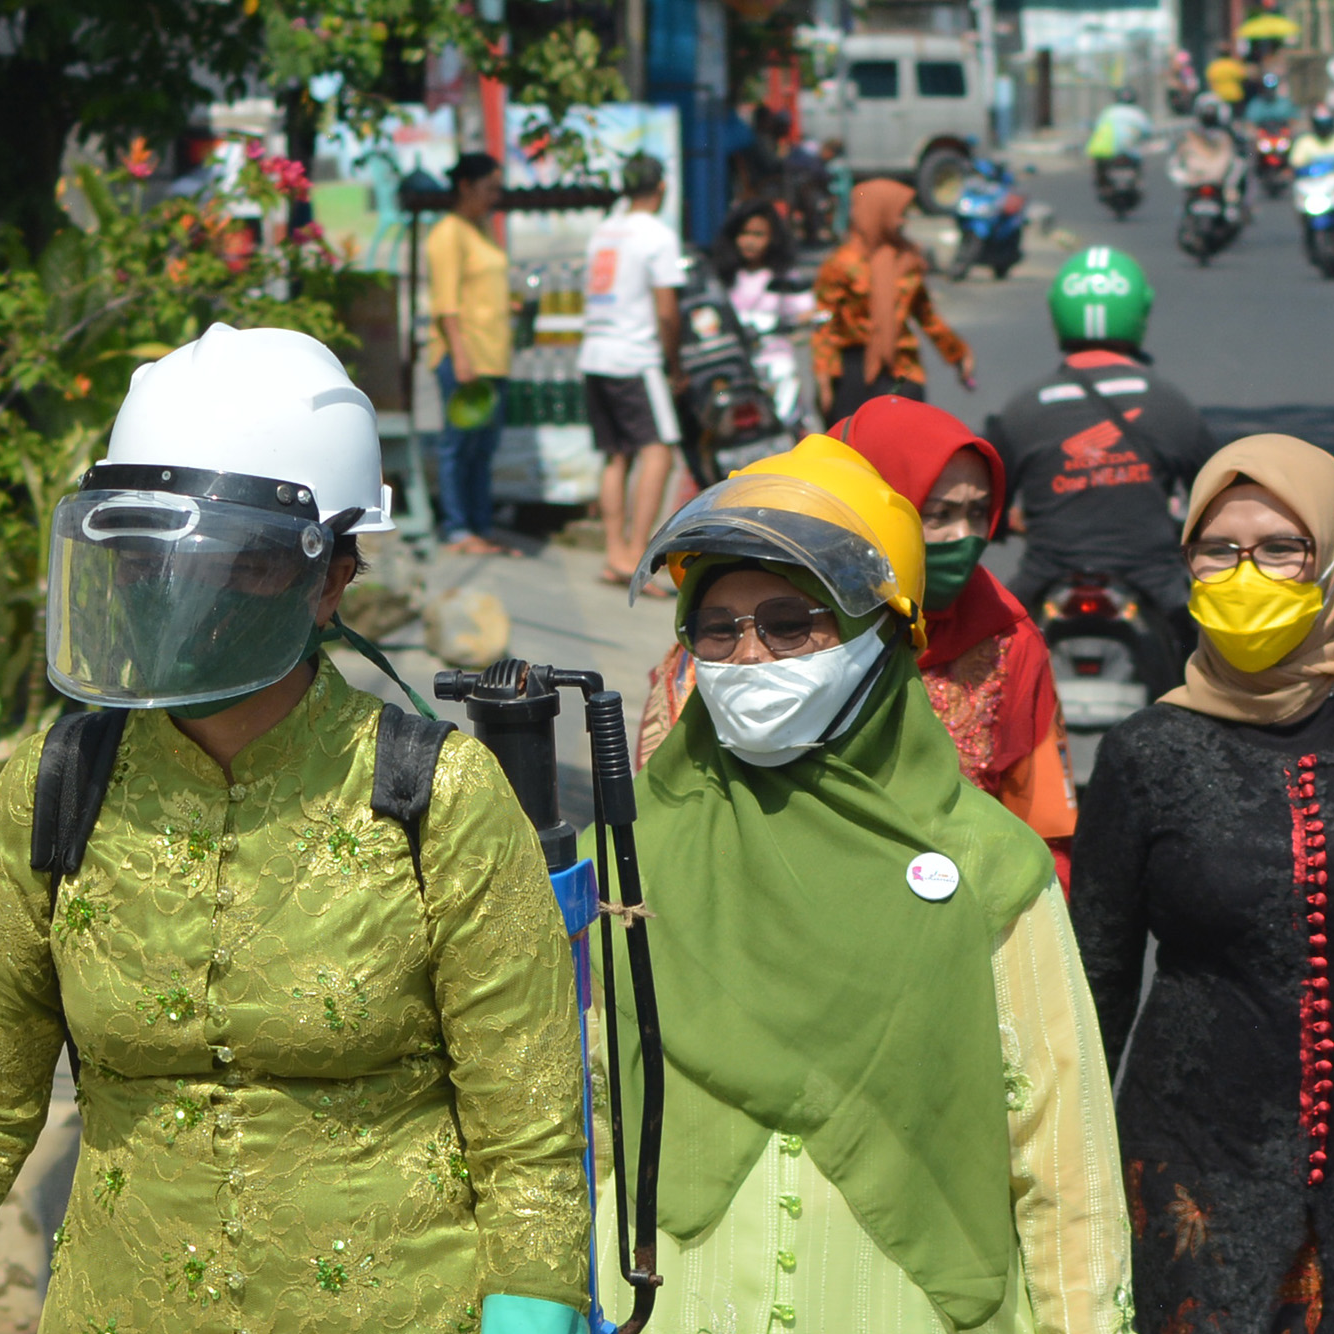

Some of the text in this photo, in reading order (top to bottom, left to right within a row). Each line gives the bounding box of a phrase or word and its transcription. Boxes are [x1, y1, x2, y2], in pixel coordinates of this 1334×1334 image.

[1063, 269, 1131, 297] Grab
[1064, 451, 1138, 471] HONDA
[1052, 475, 1088, 494] One
